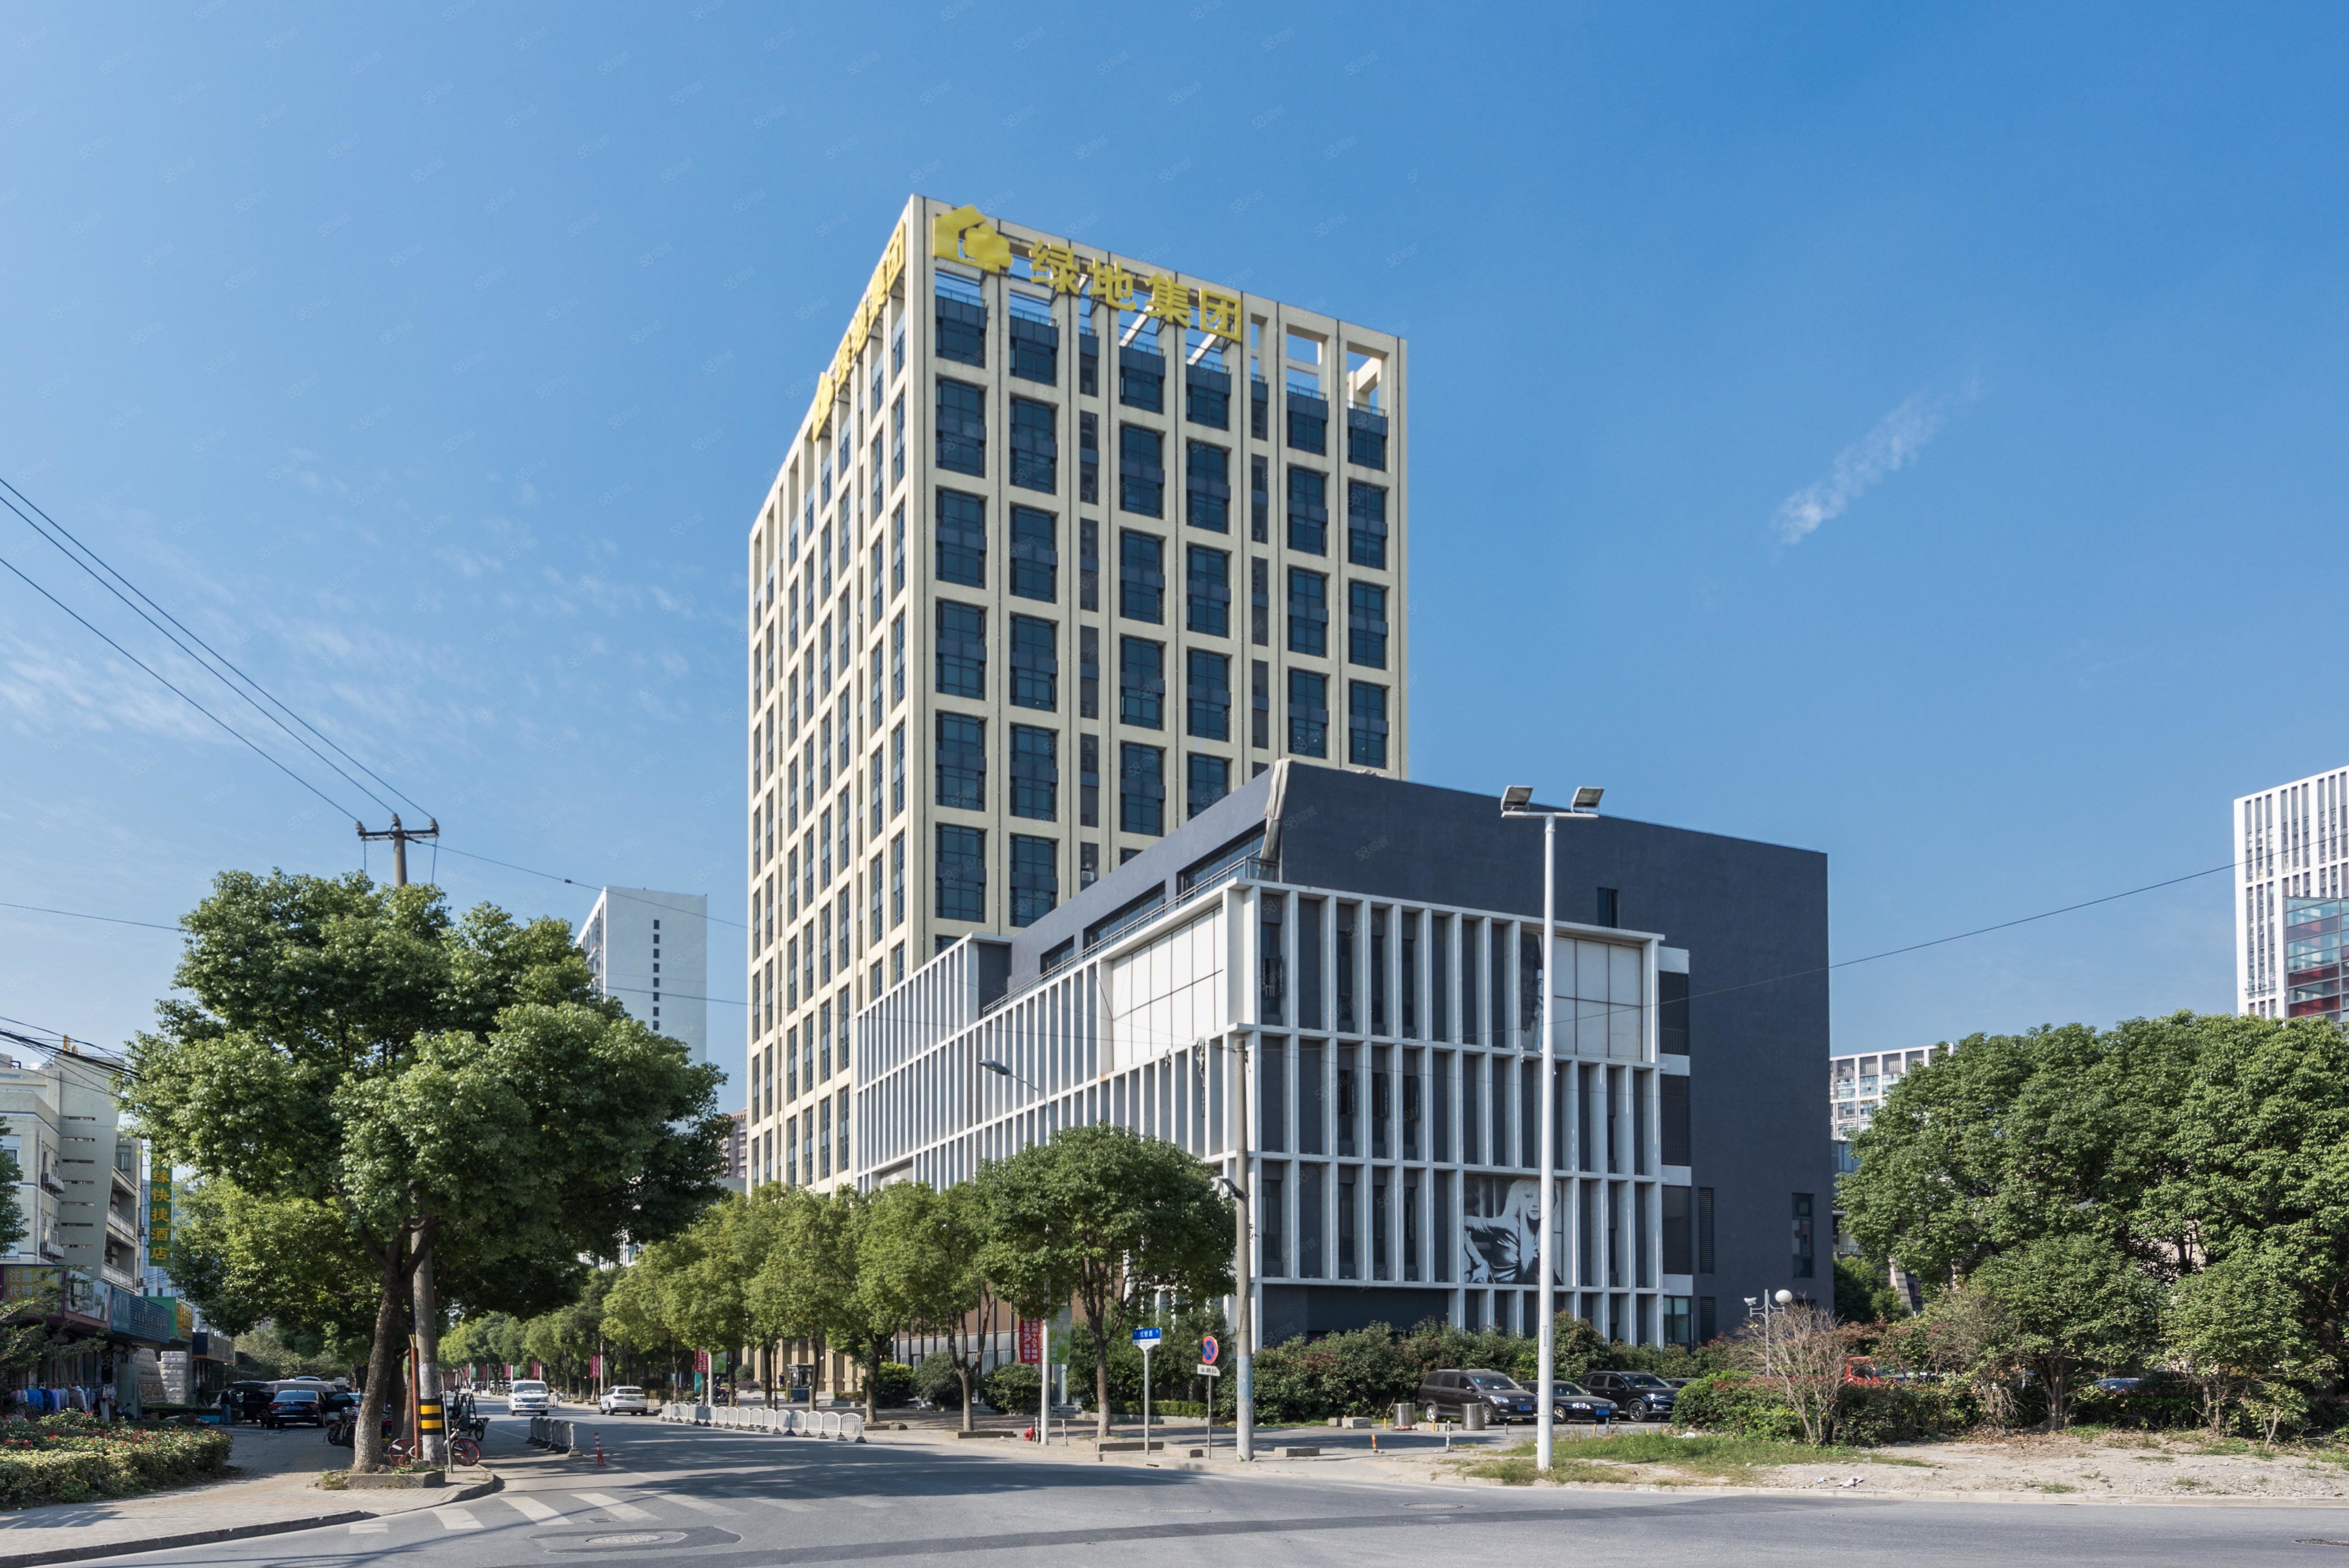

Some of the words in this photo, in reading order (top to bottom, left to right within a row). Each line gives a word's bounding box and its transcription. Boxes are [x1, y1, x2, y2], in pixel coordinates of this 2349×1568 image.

[1028, 240, 1242, 343] 绿地集团
[150, 1159, 170, 1261] 缘快捷酒店
